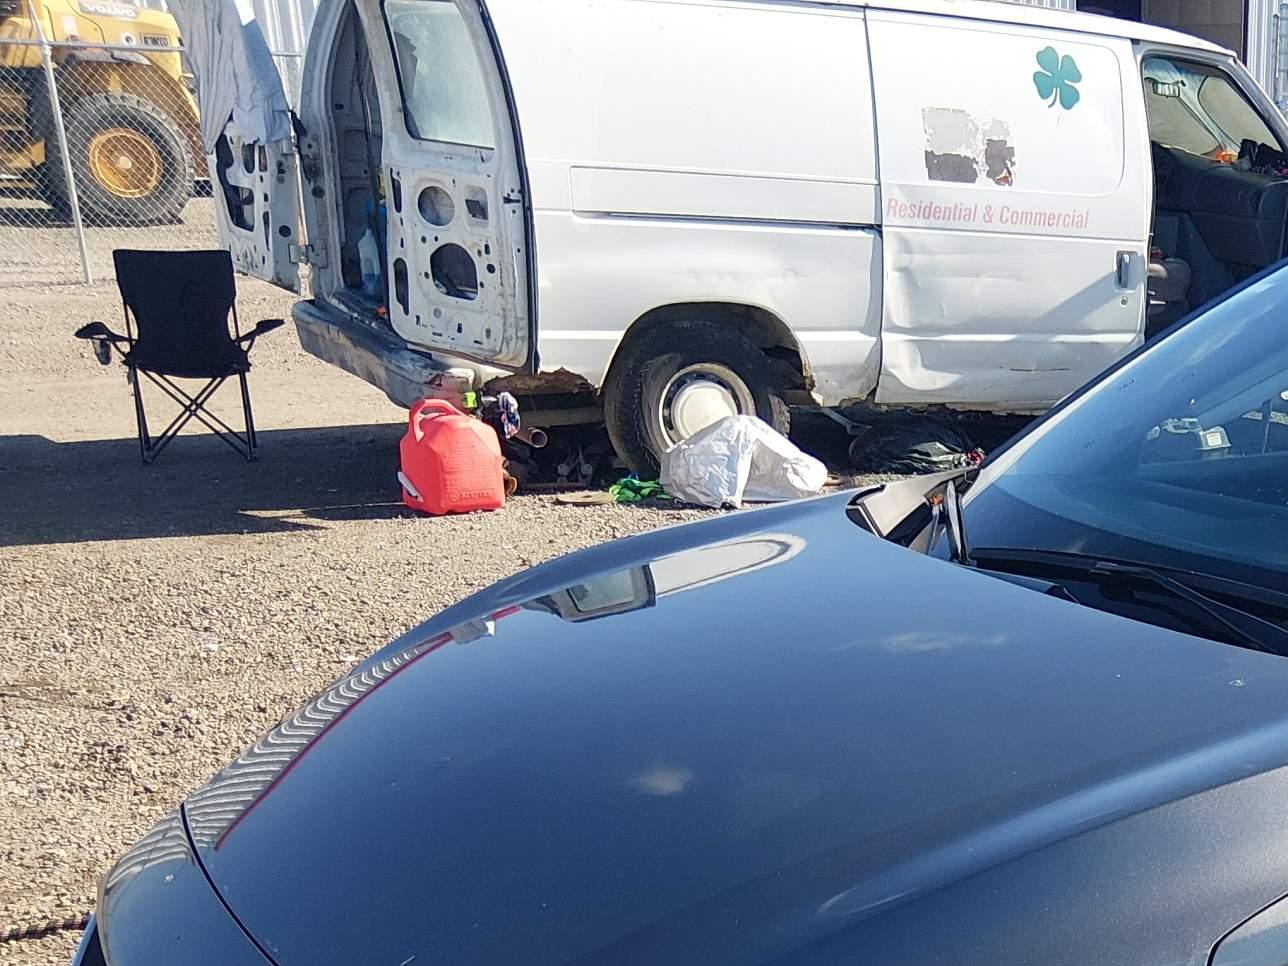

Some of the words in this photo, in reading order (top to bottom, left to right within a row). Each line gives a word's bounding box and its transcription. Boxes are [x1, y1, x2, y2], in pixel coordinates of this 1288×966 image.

[86, 3, 136, 18] VOLVO
[886, 198, 978, 223] Residential
[982, 204, 994, 224] &
[1000, 204, 1089, 229] Commercial
